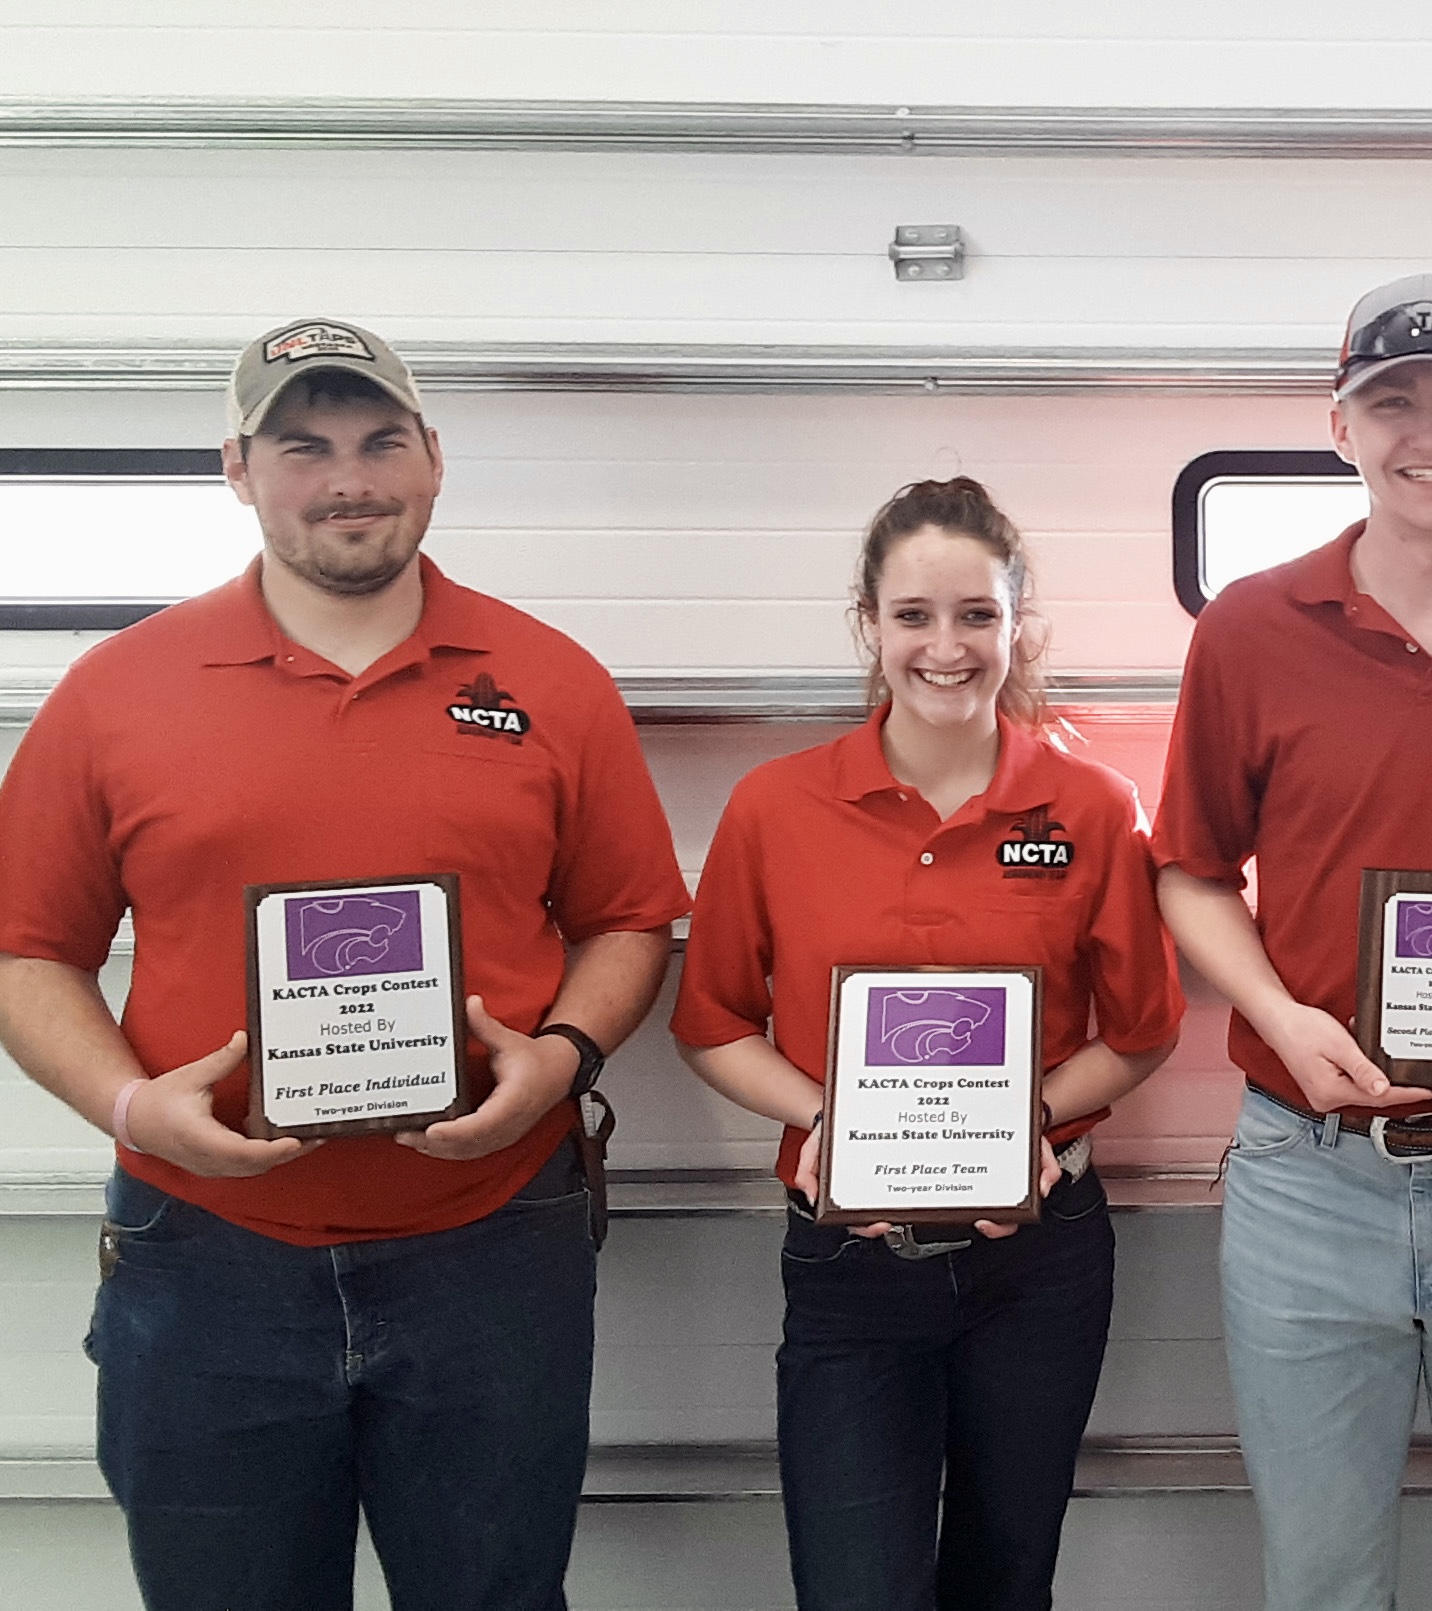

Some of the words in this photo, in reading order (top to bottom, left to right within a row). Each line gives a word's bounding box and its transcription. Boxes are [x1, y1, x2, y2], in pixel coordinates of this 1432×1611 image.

[450, 707, 522, 732] NCTA
[1003, 843, 1068, 863] NCTA
[1391, 966, 1423, 975] KACTA
[272, 985, 329, 1000] KACTA
[333, 982, 377, 997] Crops
[381, 977, 439, 992] Contest
[339, 1003, 375, 1015] 2022
[1386, 1002, 1416, 1011] Kansas
[320, 1019, 371, 1036] Hosted
[377, 1019, 396, 1032] By
[1387, 1027, 1417, 1035] Second
[268, 1046, 321, 1060] Kansas
[326, 1042, 365, 1055] State
[369, 1034, 448, 1051] University
[275, 1084, 314, 1099] First
[318, 1081, 360, 1095] Place
[365, 1071, 446, 1091] Individual
[858, 1078, 909, 1089] KACTA
[913, 1078, 954, 1091] Crops
[957, 1078, 1010, 1088] Contest
[917, 1097, 950, 1105] 2022
[314, 1104, 363, 1117] Two-year
[367, 1099, 408, 1111] Division
[898, 1111, 945, 1123] Hosted
[951, 1111, 968, 1125] By
[849, 1130, 898, 1140] Kansas
[901, 1130, 938, 1140] State
[942, 1129, 1015, 1141] University
[874, 1165, 907, 1175] First
[911, 1164, 947, 1174] Place
[952, 1164, 988, 1174] Team
[887, 1185, 932, 1193] Two-year
